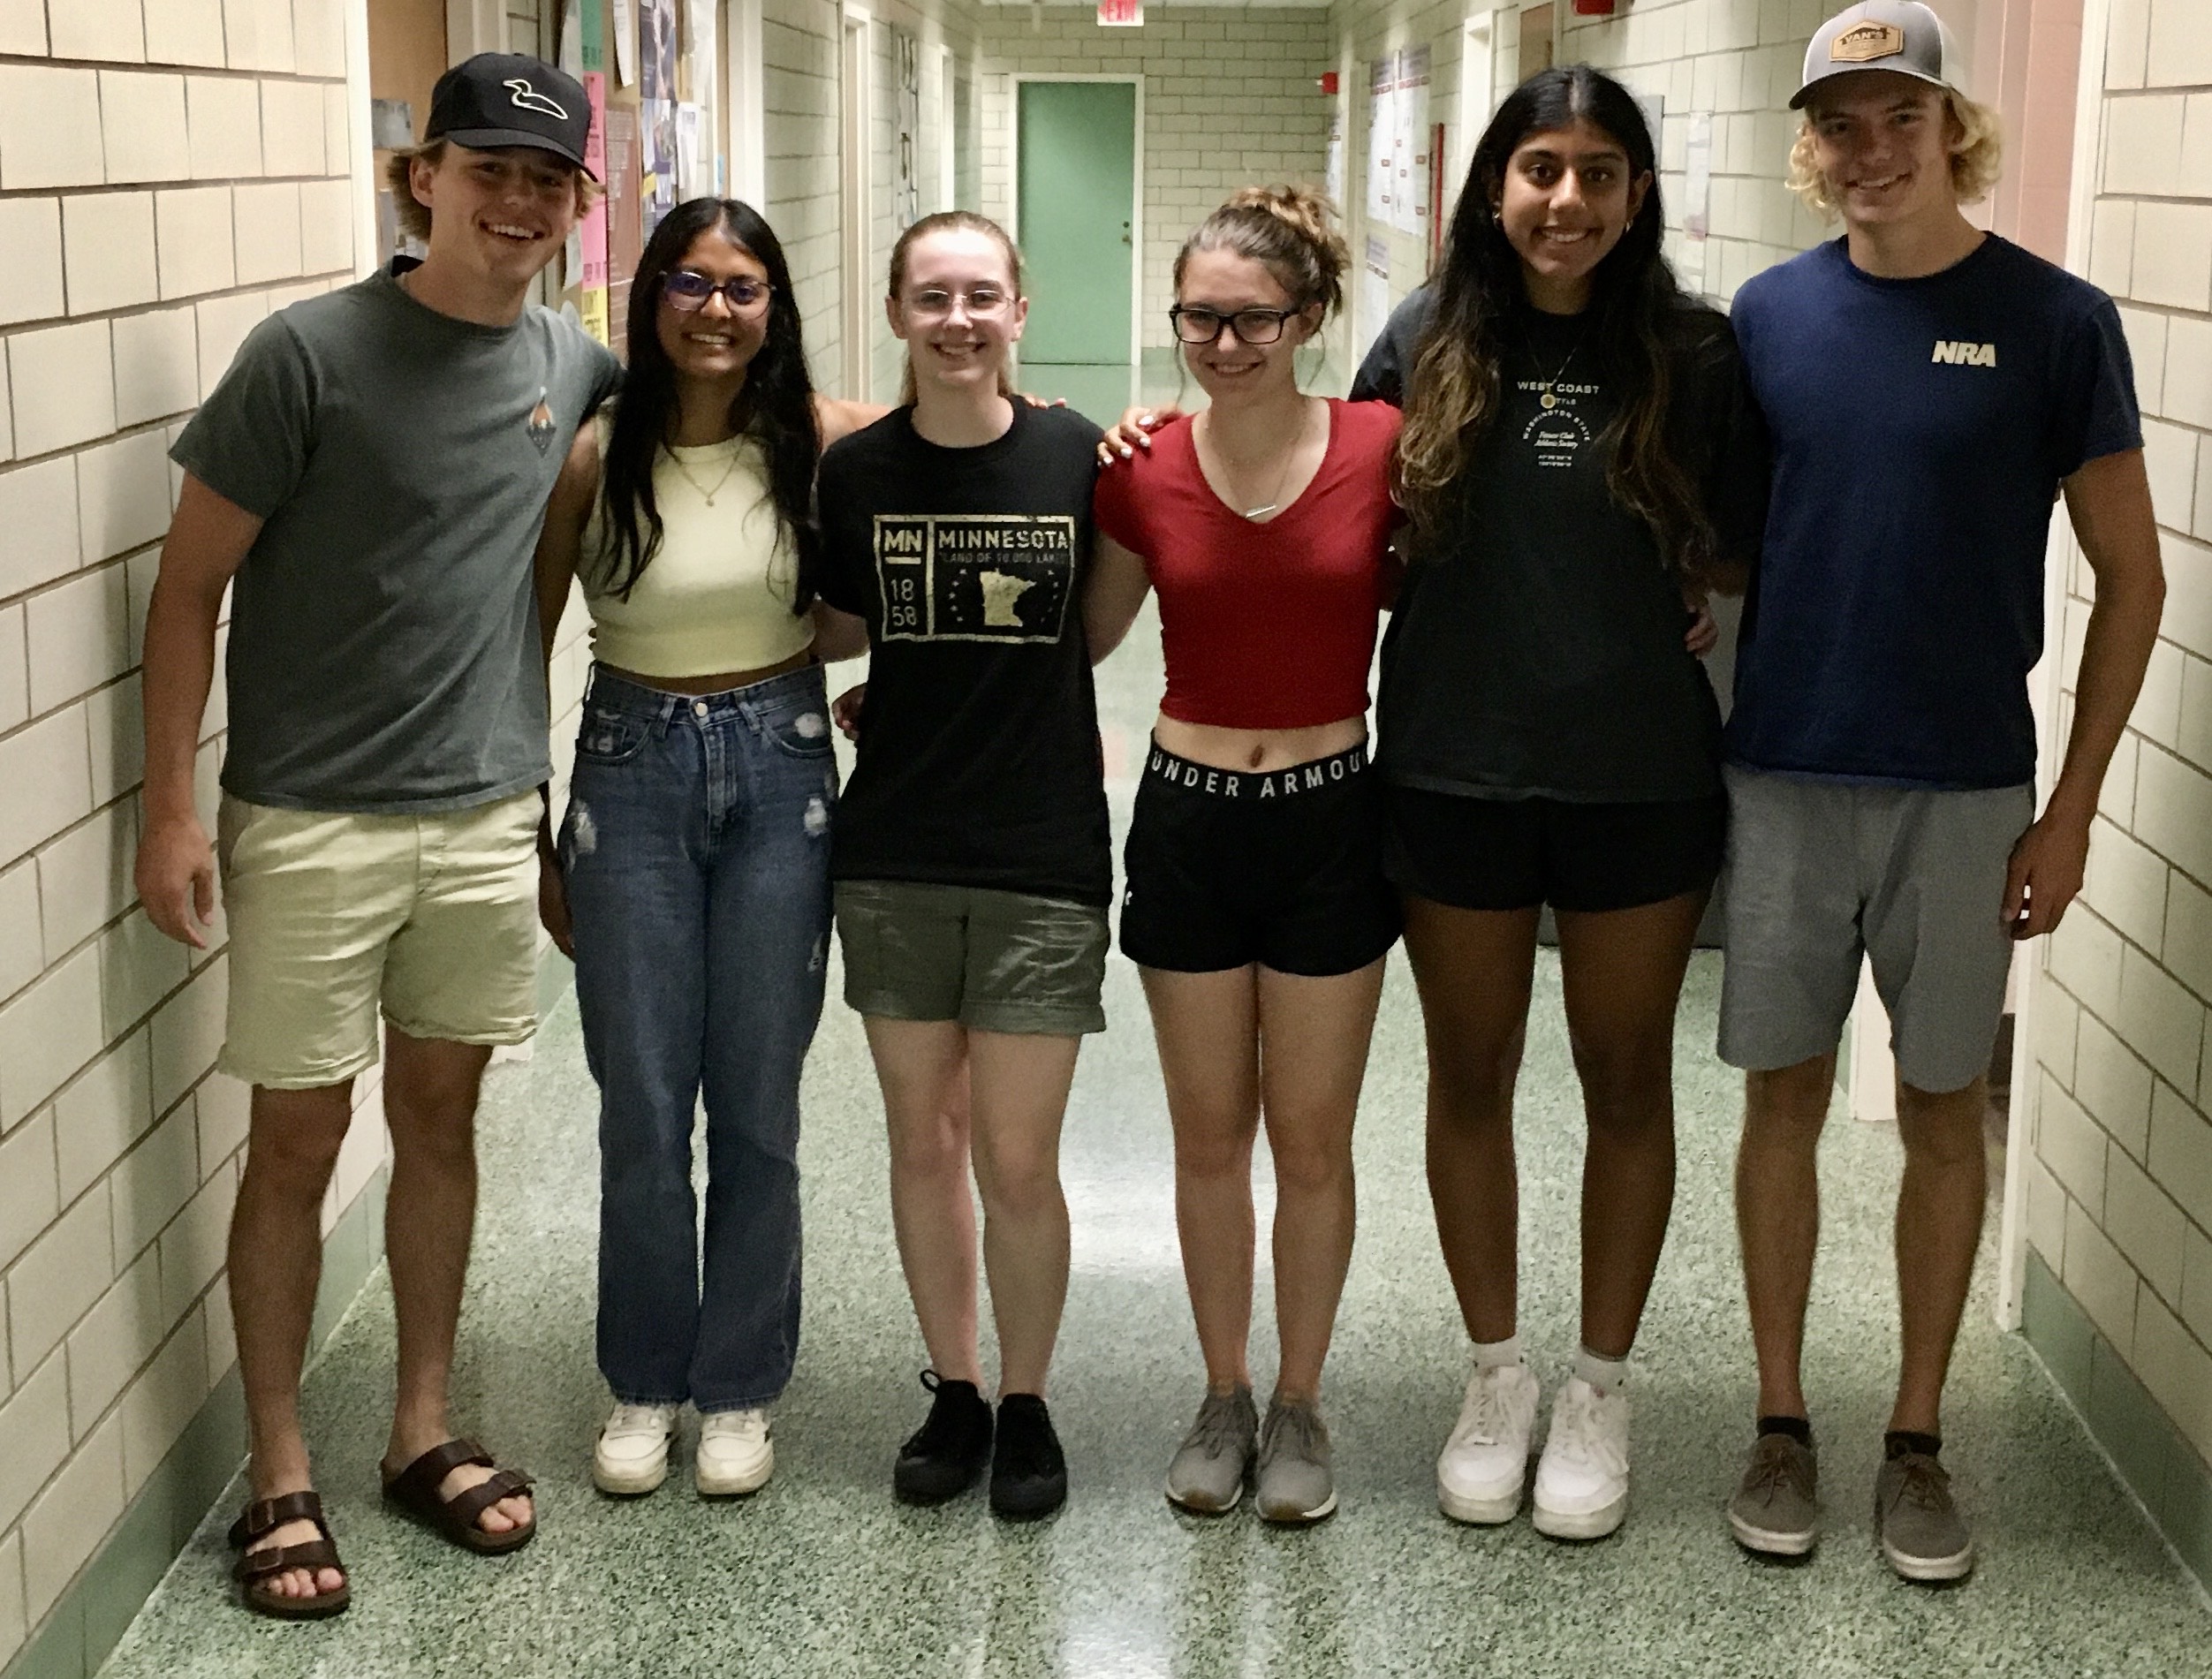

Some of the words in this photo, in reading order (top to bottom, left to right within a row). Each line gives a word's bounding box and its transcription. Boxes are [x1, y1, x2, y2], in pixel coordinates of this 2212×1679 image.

[1931, 340, 1996, 367] NRA
[1517, 382, 1553, 391] WEST
[1557, 383, 1599, 394] COAST
[884, 529, 922, 552] MN
[939, 530, 1068, 548] MINNESOTA
[890, 579, 913, 601] 18
[892, 605, 916, 626] 58
[1151, 750, 1239, 797] UNDER
